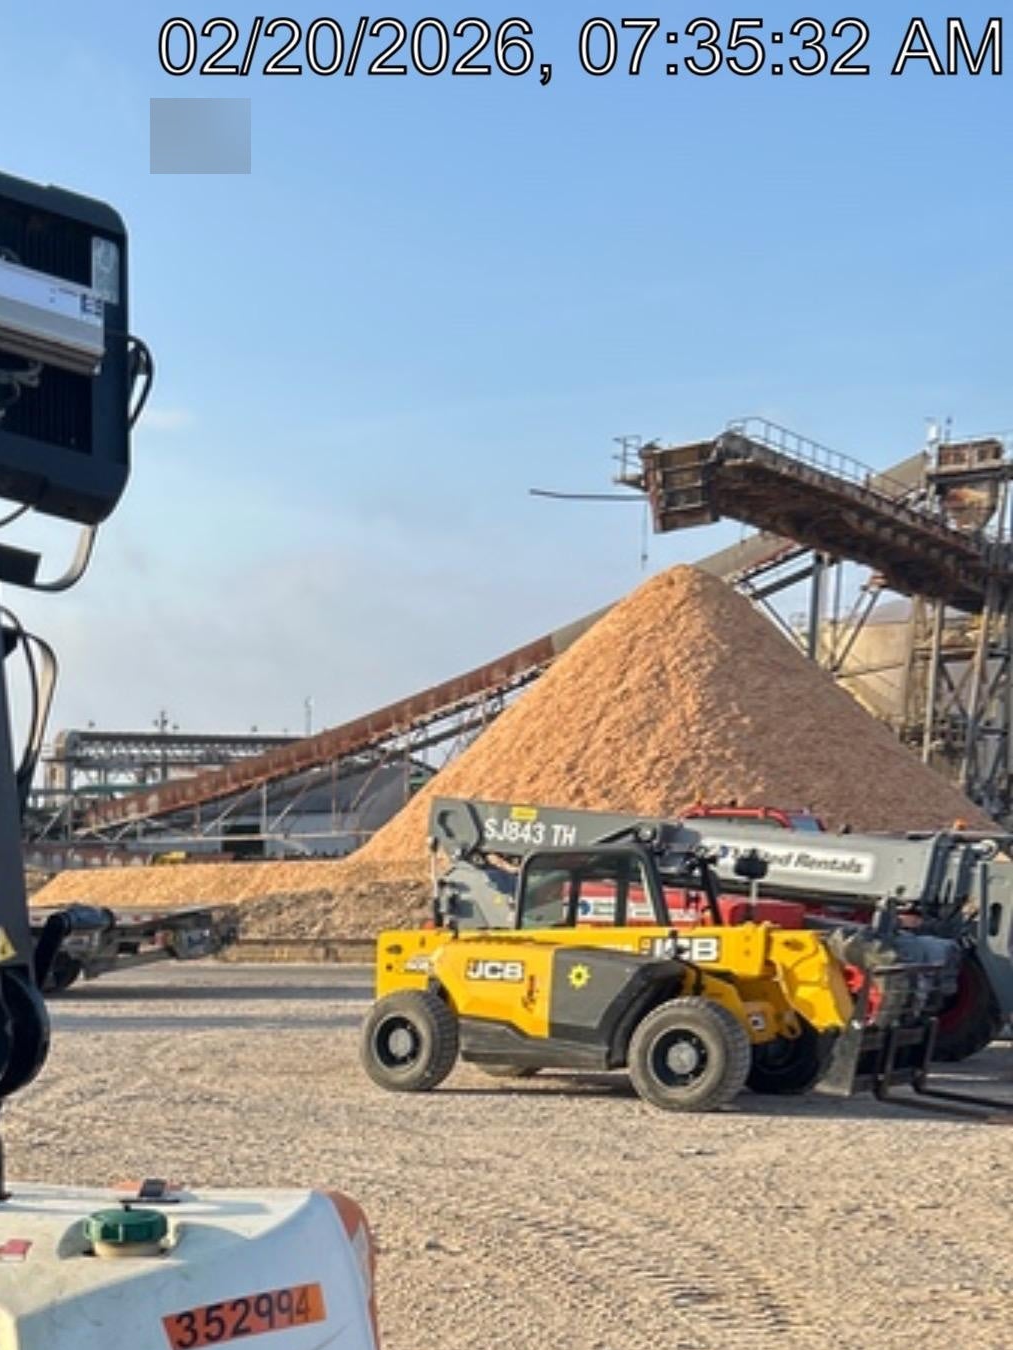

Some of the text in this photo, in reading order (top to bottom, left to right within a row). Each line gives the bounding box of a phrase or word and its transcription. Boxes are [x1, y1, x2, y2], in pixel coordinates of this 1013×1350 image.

[484, 818, 576, 846] SJ843 TH
[467, 961, 523, 981] JCB
[175, 1286, 311, 1349] 352994
